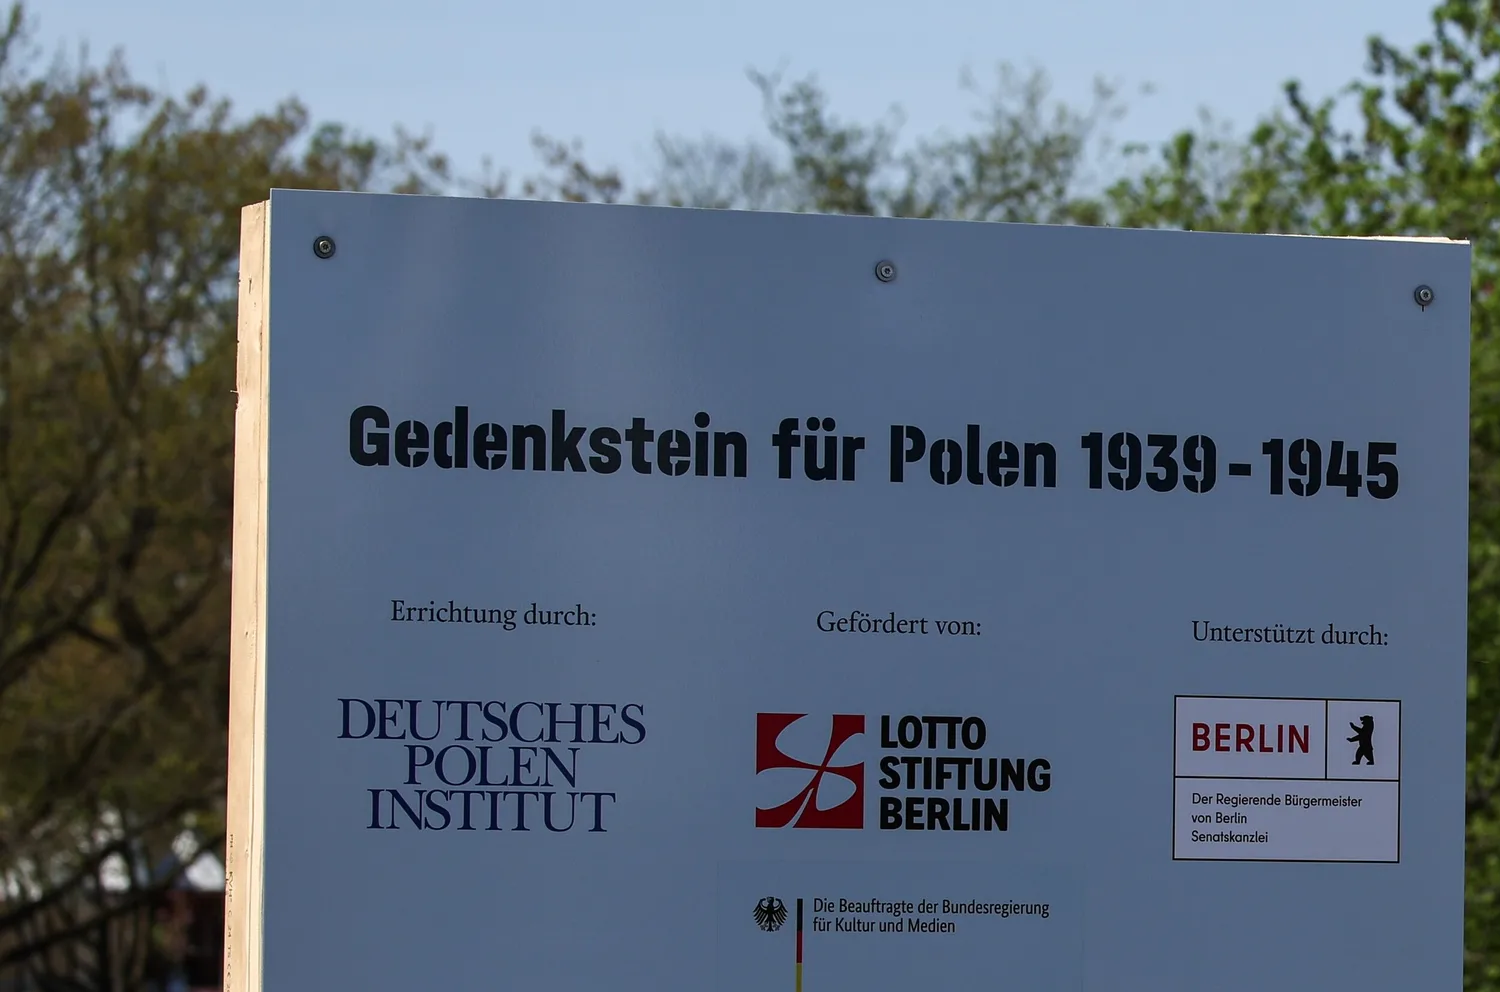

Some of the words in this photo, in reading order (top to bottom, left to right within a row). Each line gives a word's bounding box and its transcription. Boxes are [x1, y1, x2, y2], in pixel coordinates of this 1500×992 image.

[349, 405, 748, 478] Gedenkstein
[771, 416, 866, 482] für
[889, 423, 1057, 488] Polen
[390, 599, 518, 631] Errichtung
[523, 602, 596, 627] durch:
[816, 610, 929, 635] Gefördert
[934, 620, 981, 636] von:
[1191, 620, 1316, 644] Unterstützt
[1321, 623, 1388, 646] durch:
[336, 698, 646, 745] DEUTSCHES
[880, 714, 987, 751] LOTTO
[1192, 722, 1310, 754] BERLIN
[402, 744, 581, 788] POLEN
[878, 755, 1051, 793] STIFTUNG
[366, 788, 616, 833] INSTITUT
[879, 796, 1009, 832] BERLIN
[1192, 792, 1213, 805] Der
[1215, 792, 1282, 808] Regierende
[1284, 793, 1363, 809] Bürgermeister
[1191, 814, 1212, 824] von
[1215, 810, 1248, 824] Berlin
[1191, 829, 1269, 843] Senatskanzlei
[813, 897, 835, 913] Die
[839, 897, 914, 919] Beauftragte
[917, 898, 939, 914] der
[942, 899, 1050, 919] Bundesregierung
[227, 925, 233, 938] 24
[812, 916, 832, 932] für
[835, 916, 876, 933] Kultur
[878, 916, 904, 933] und
[907, 917, 956, 933] Medien
